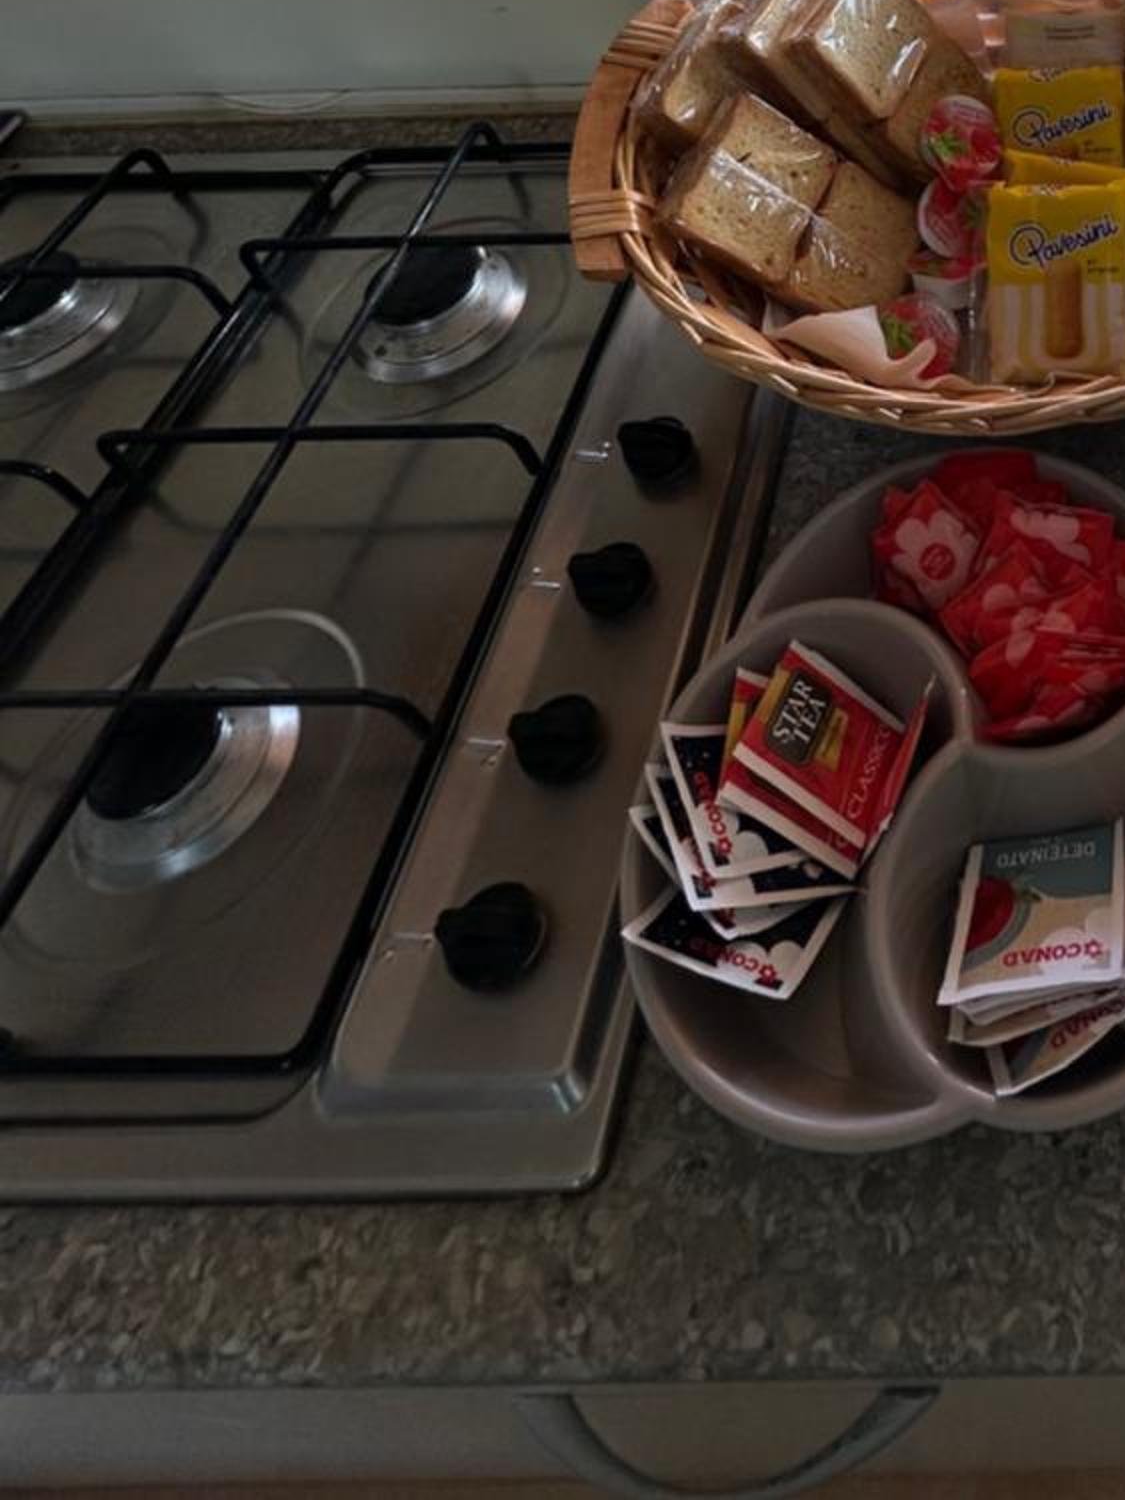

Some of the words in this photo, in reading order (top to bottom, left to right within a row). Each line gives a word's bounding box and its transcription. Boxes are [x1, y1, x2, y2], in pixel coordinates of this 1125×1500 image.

[1012, 101, 1112, 149] Pavesini
[1009, 214, 1118, 268] Pavesini
[772, 679, 816, 745] STAR
[792, 698, 827, 744] TEA
[996, 841, 1096, 869] DETEINATO
[1002, 943, 1081, 969] CONAD
